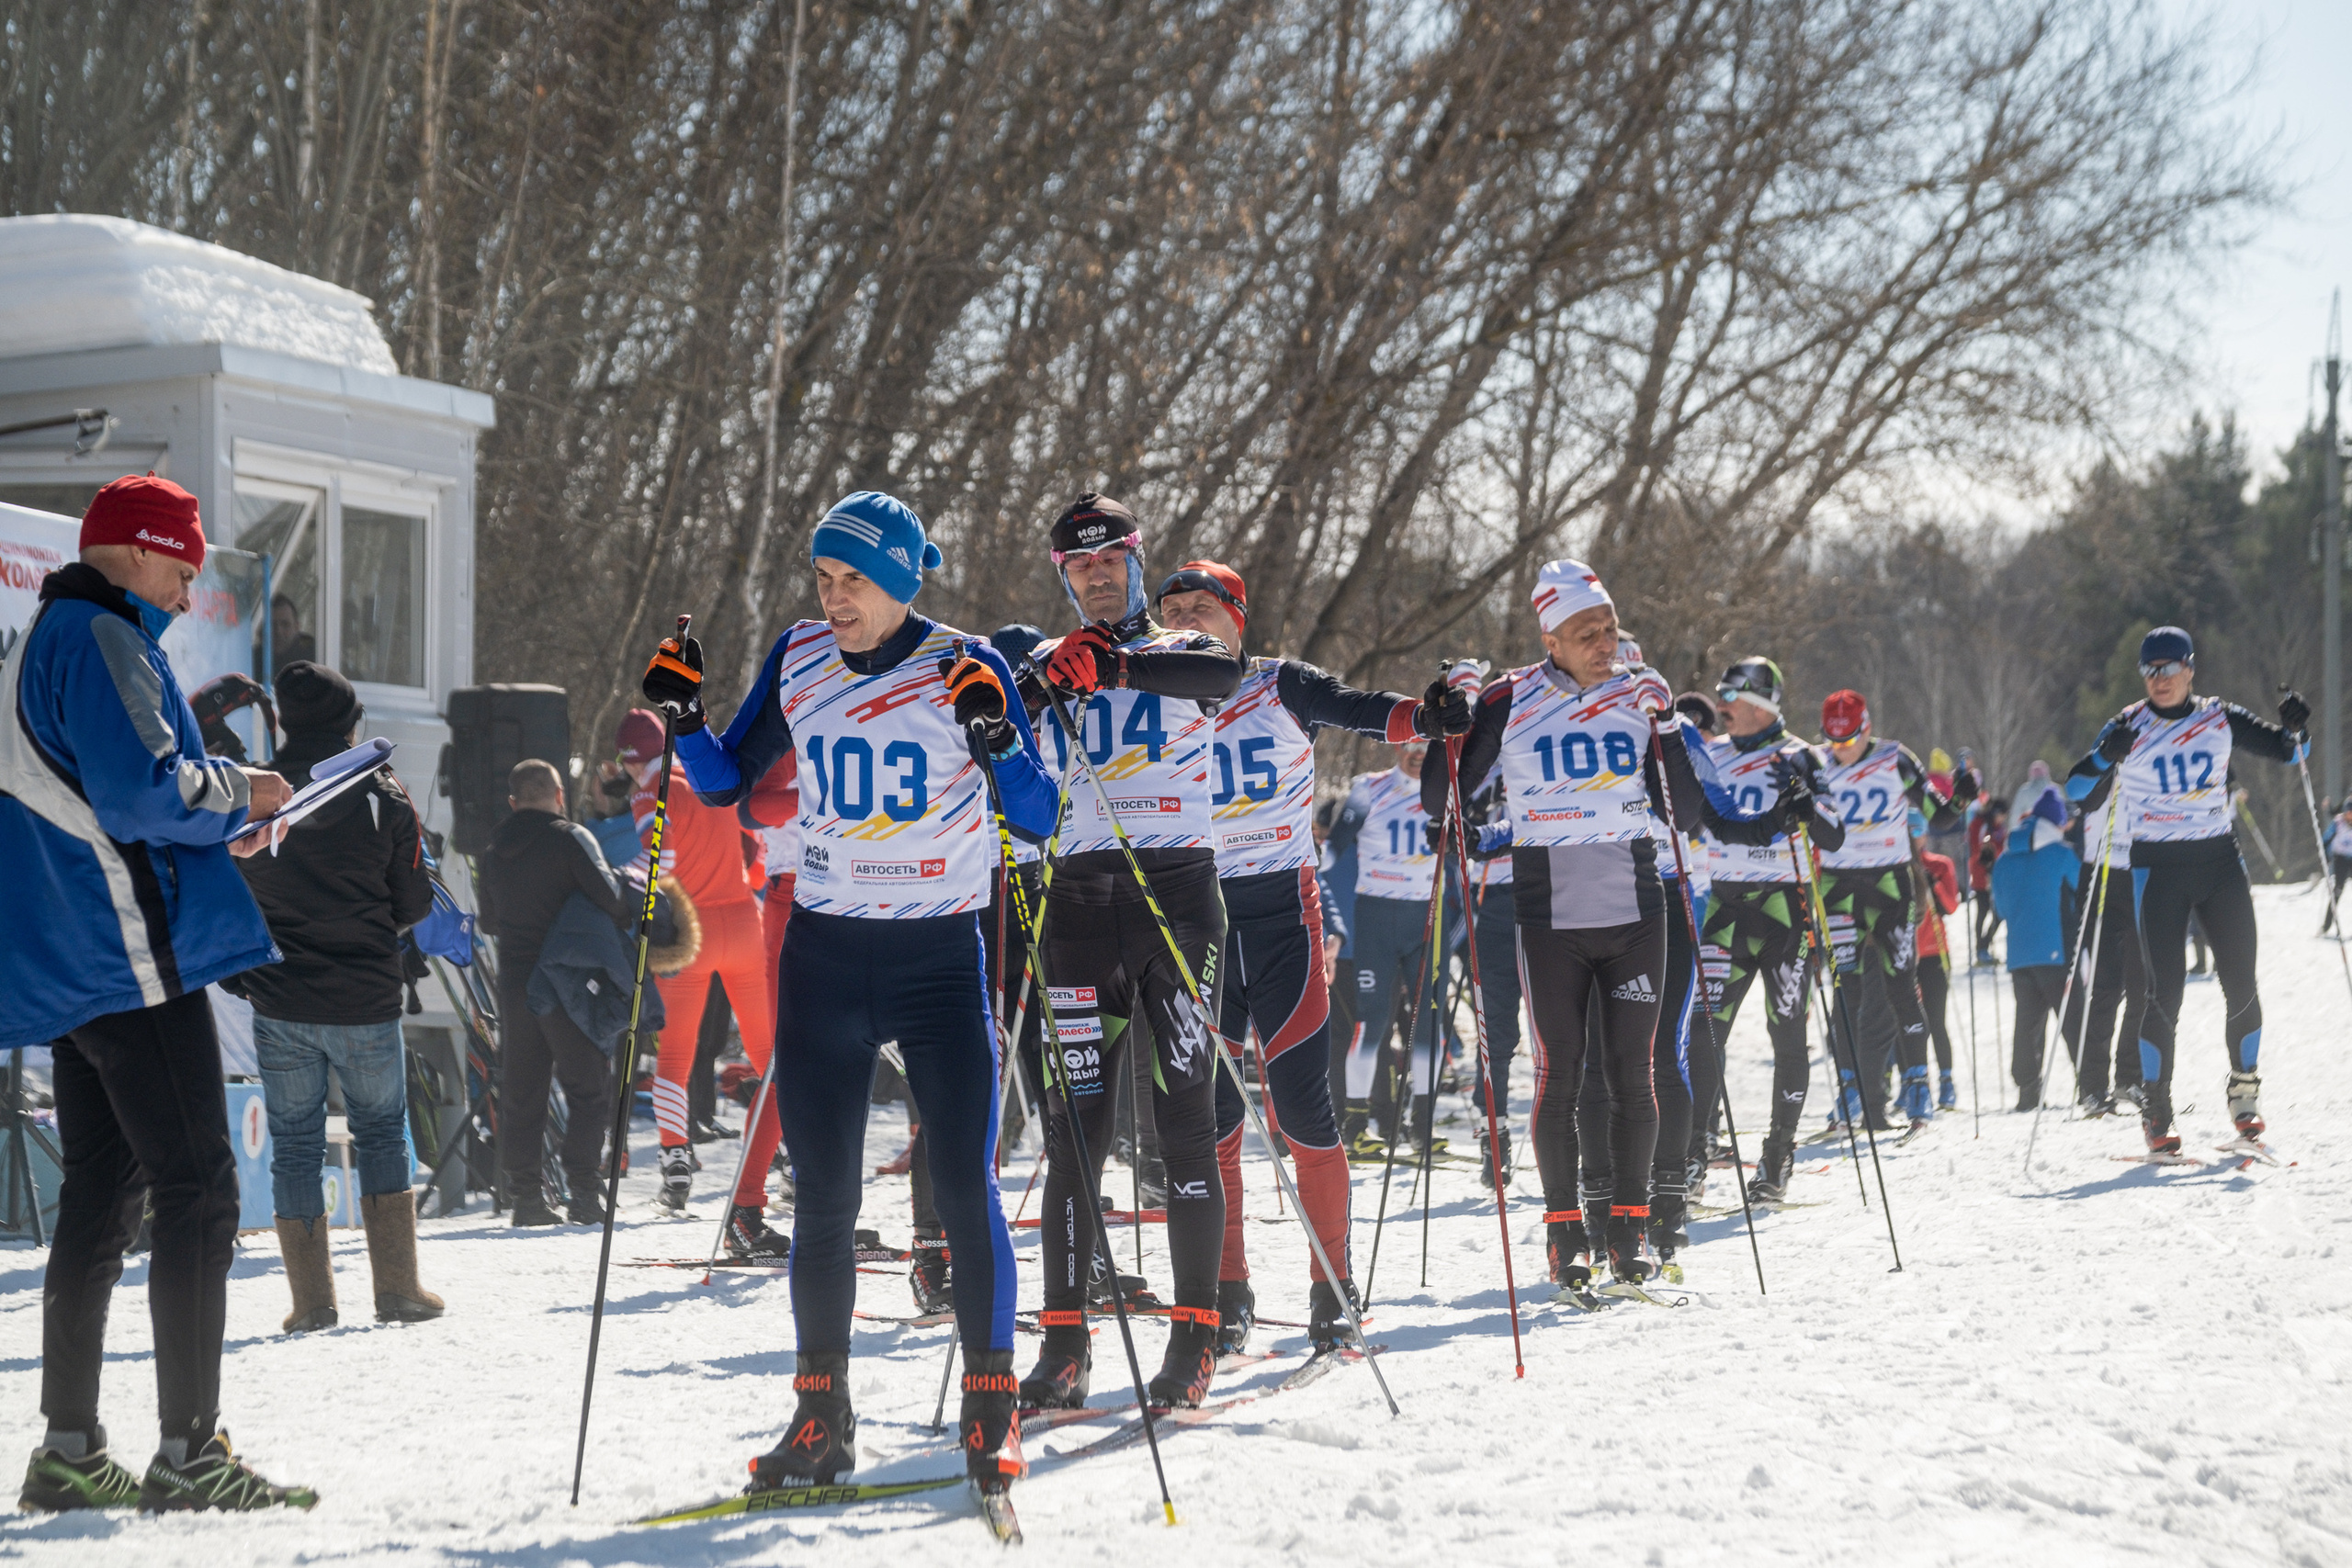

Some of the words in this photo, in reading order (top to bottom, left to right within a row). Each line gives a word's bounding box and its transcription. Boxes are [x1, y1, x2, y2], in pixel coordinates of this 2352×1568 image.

[151, 535, 184, 550] odlo
[1078, 525, 1106, 538] МОЙ
[887, 549, 912, 570] adidas
[1046, 692, 1168, 772] 104
[1533, 731, 1637, 782] 108
[806, 735, 928, 822] 103
[1212, 736, 1277, 806] 05
[2153, 750, 2213, 794] 112
[1101, 800, 1157, 811] ТОСЕТЬ
[1162, 800, 1178, 808] РФ
[1727, 783, 1763, 812] 10
[1840, 787, 1891, 824] 22
[650, 799, 665, 858] LEKI
[995, 813, 1017, 868] LEKI
[1227, 832, 1275, 844] АВТОСЕТЬ
[1278, 829, 1290, 837] РФ
[855, 864, 917, 874] АВТОСЕТЬ
[923, 863, 943, 873] РФ
[1611, 989, 1657, 1003] adidas
[1057, 1027, 1091, 1035] олесо
[1472, 980, 1492, 1082] SWIX
[250, 1106, 257, 1145] 1
[1067, 1197, 1075, 1247] VICTORY
[855, 1250, 894, 1260] SIGNOL
[922, 1239, 948, 1247] ROSSIG
[752, 1258, 789, 1267] ROSSIGNO
[746, 1488, 858, 1512] FISCHER
